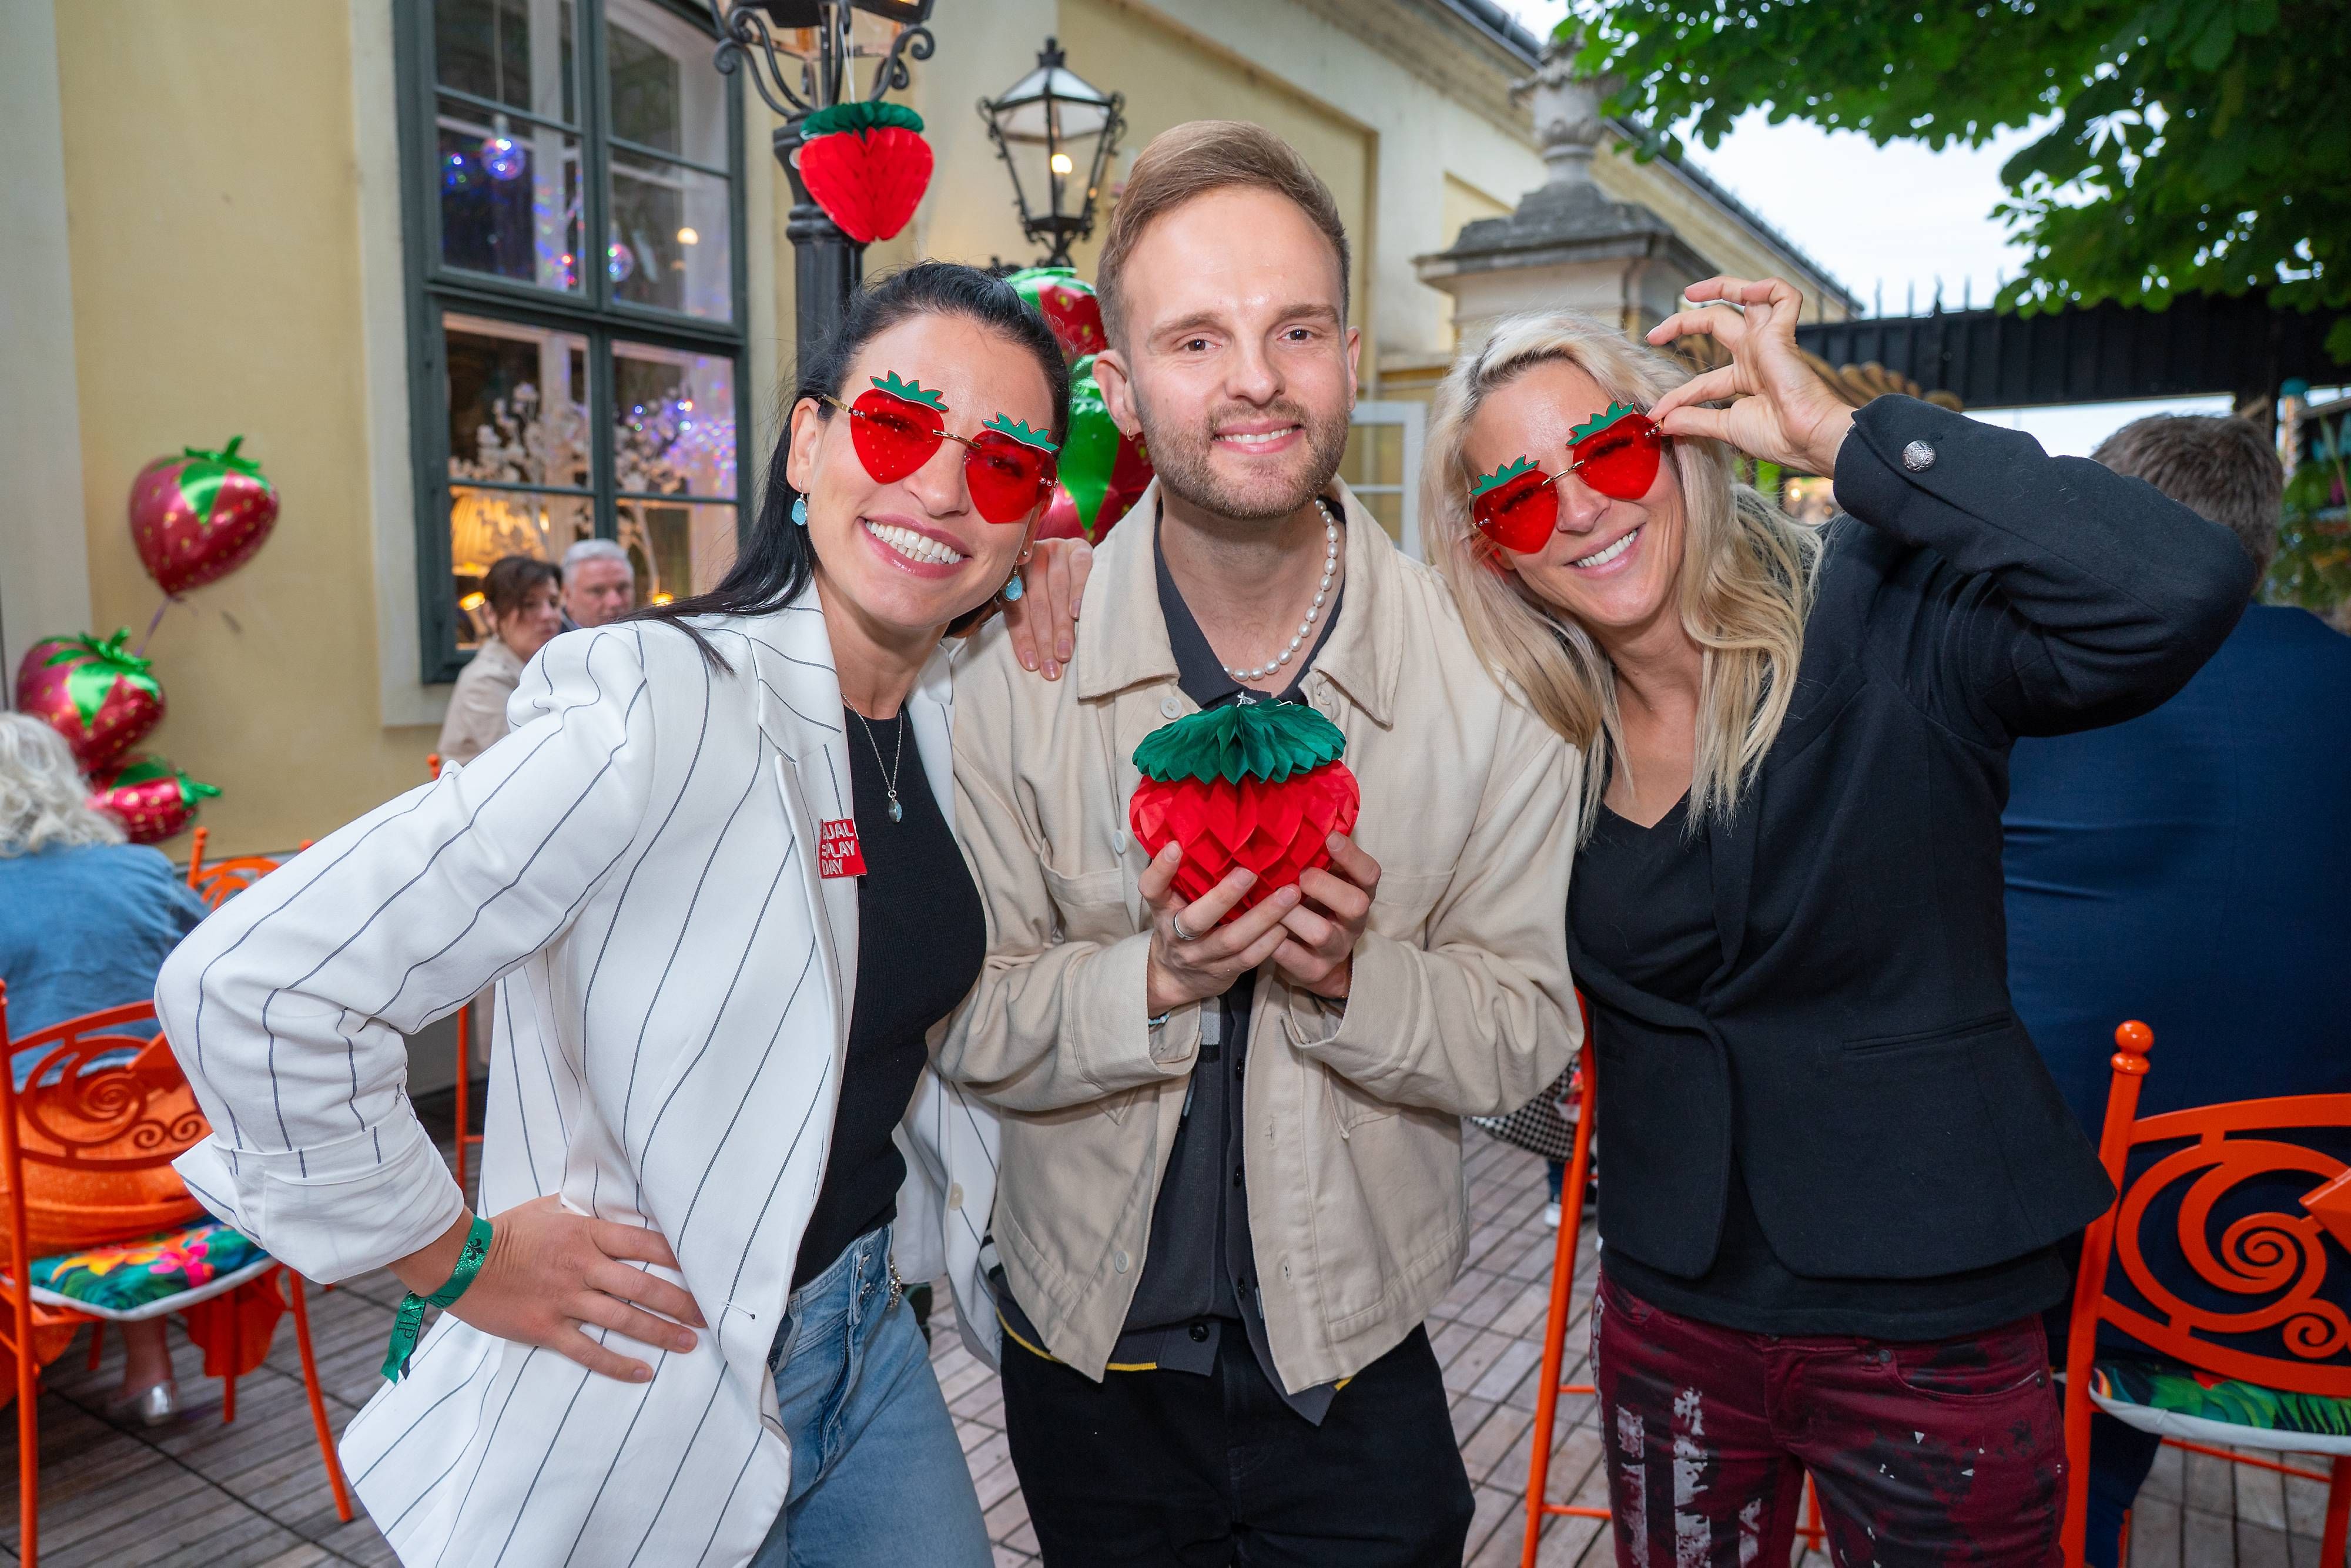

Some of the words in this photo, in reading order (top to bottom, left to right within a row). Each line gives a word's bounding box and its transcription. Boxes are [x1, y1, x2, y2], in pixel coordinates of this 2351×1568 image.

[823, 822, 854, 840] UAL
[821, 859, 843, 875] DAY
[427, 1295, 457, 1308] VI
[397, 1306, 422, 1339] VIP
